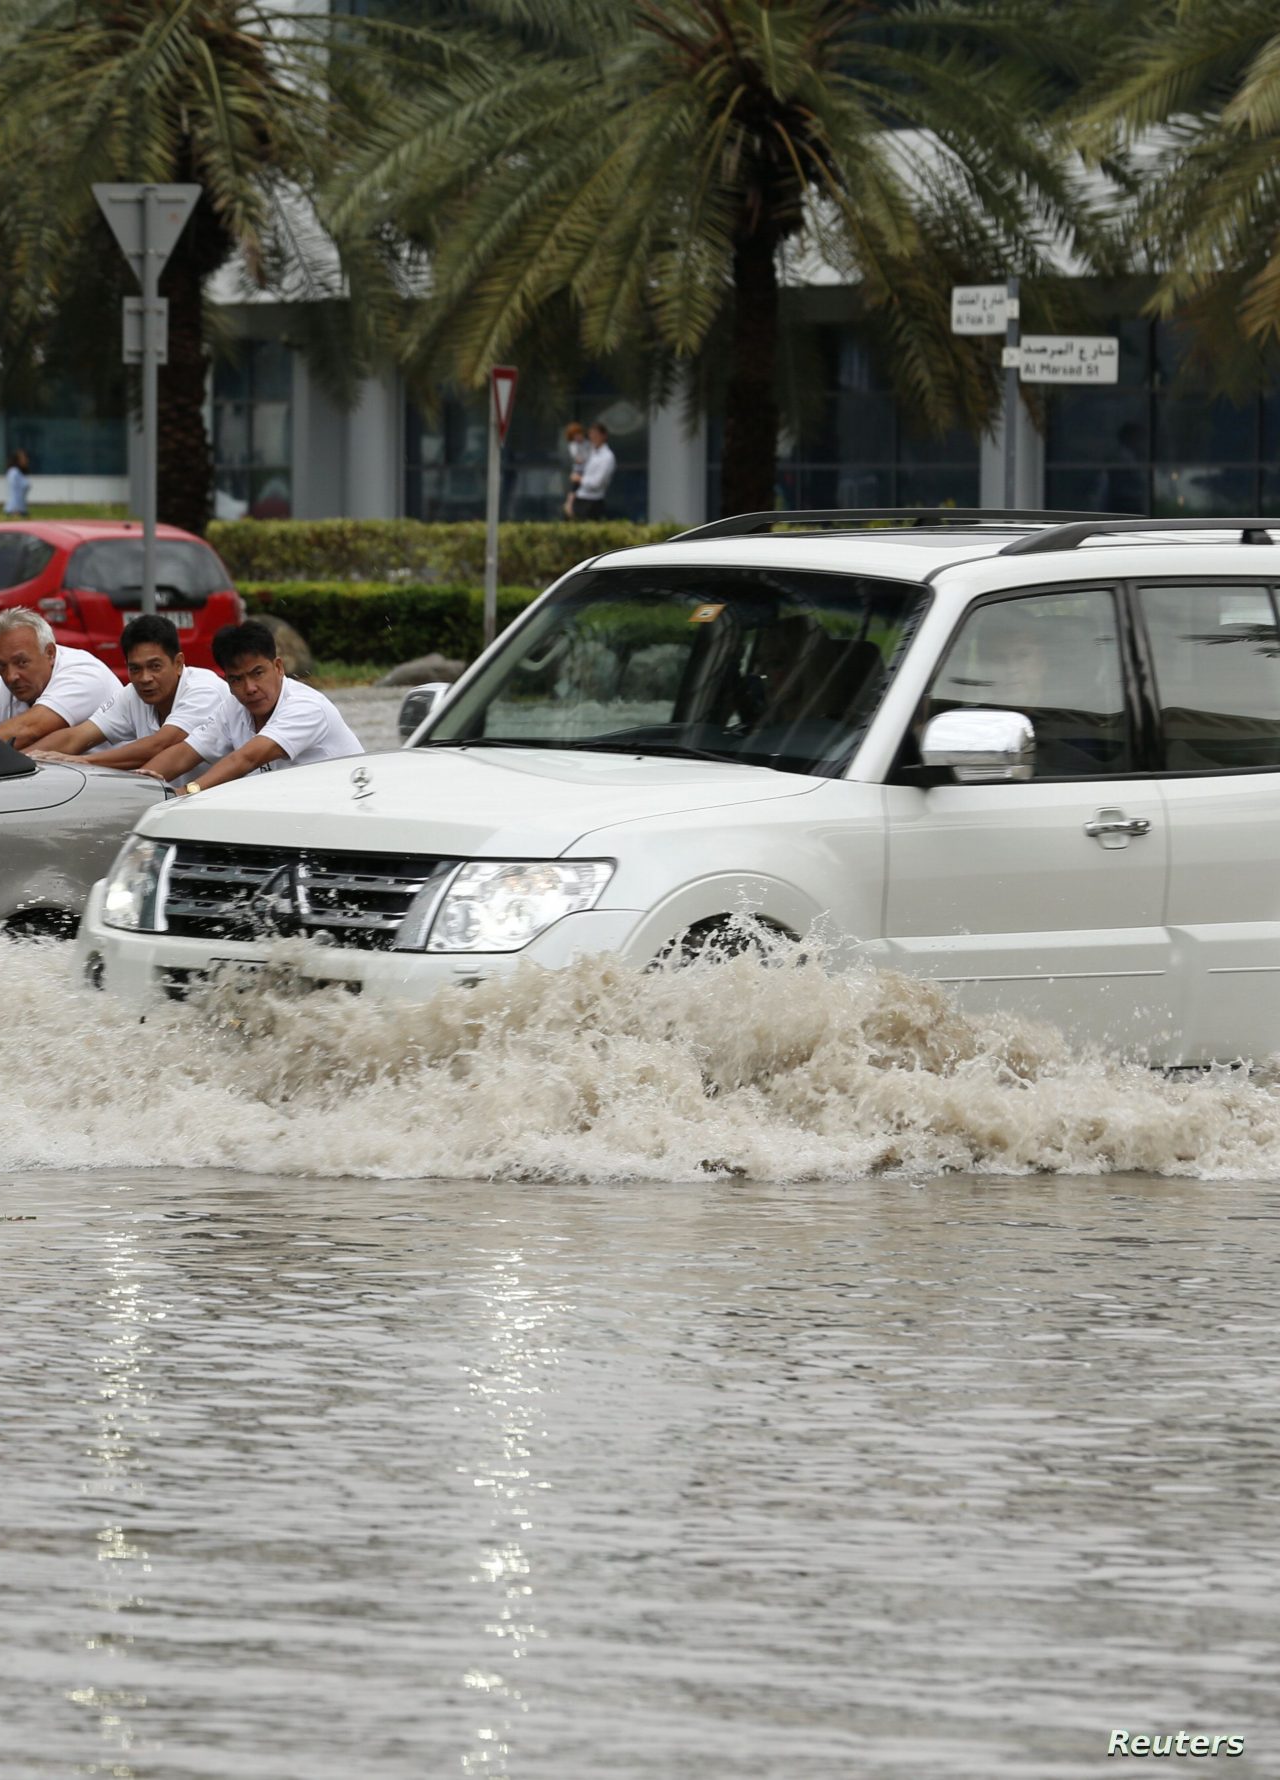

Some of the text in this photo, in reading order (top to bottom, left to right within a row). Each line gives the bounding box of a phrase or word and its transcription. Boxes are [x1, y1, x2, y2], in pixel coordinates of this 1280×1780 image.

[1023, 342, 1115, 362] شارع المرصد
[1024, 362, 1099, 376] Al Marsad St
